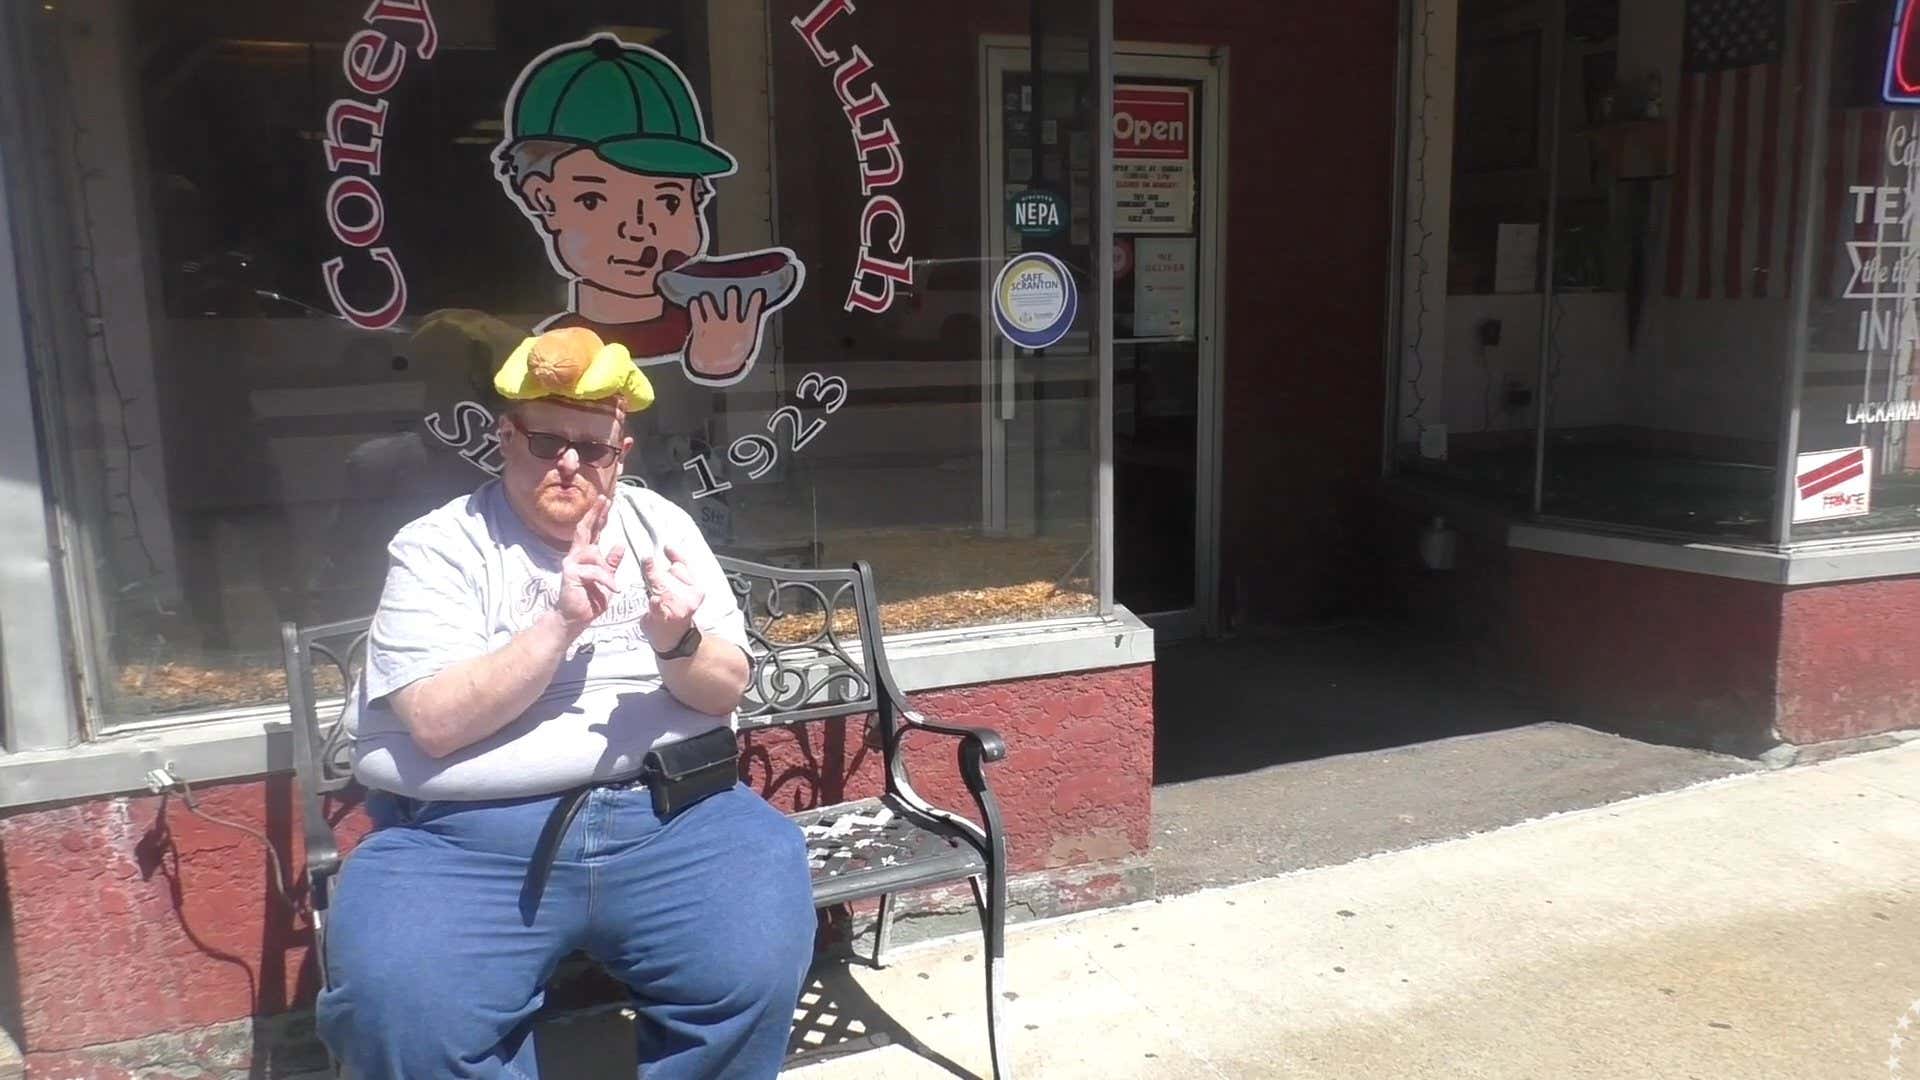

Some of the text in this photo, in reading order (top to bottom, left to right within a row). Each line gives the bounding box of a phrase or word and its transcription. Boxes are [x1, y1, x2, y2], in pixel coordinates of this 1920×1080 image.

[1112, 111, 1184, 146] Open
[322, 0, 438, 330] Coney
[791, 0, 915, 314] Lunch
[1015, 202, 1059, 225] NEPA
[1010, 279, 1059, 291] SCRANTON
[1020, 272, 1044, 283] SAFE
[1846, 399, 1920, 425] LACKAWA
[684, 371, 848, 501] 1923
